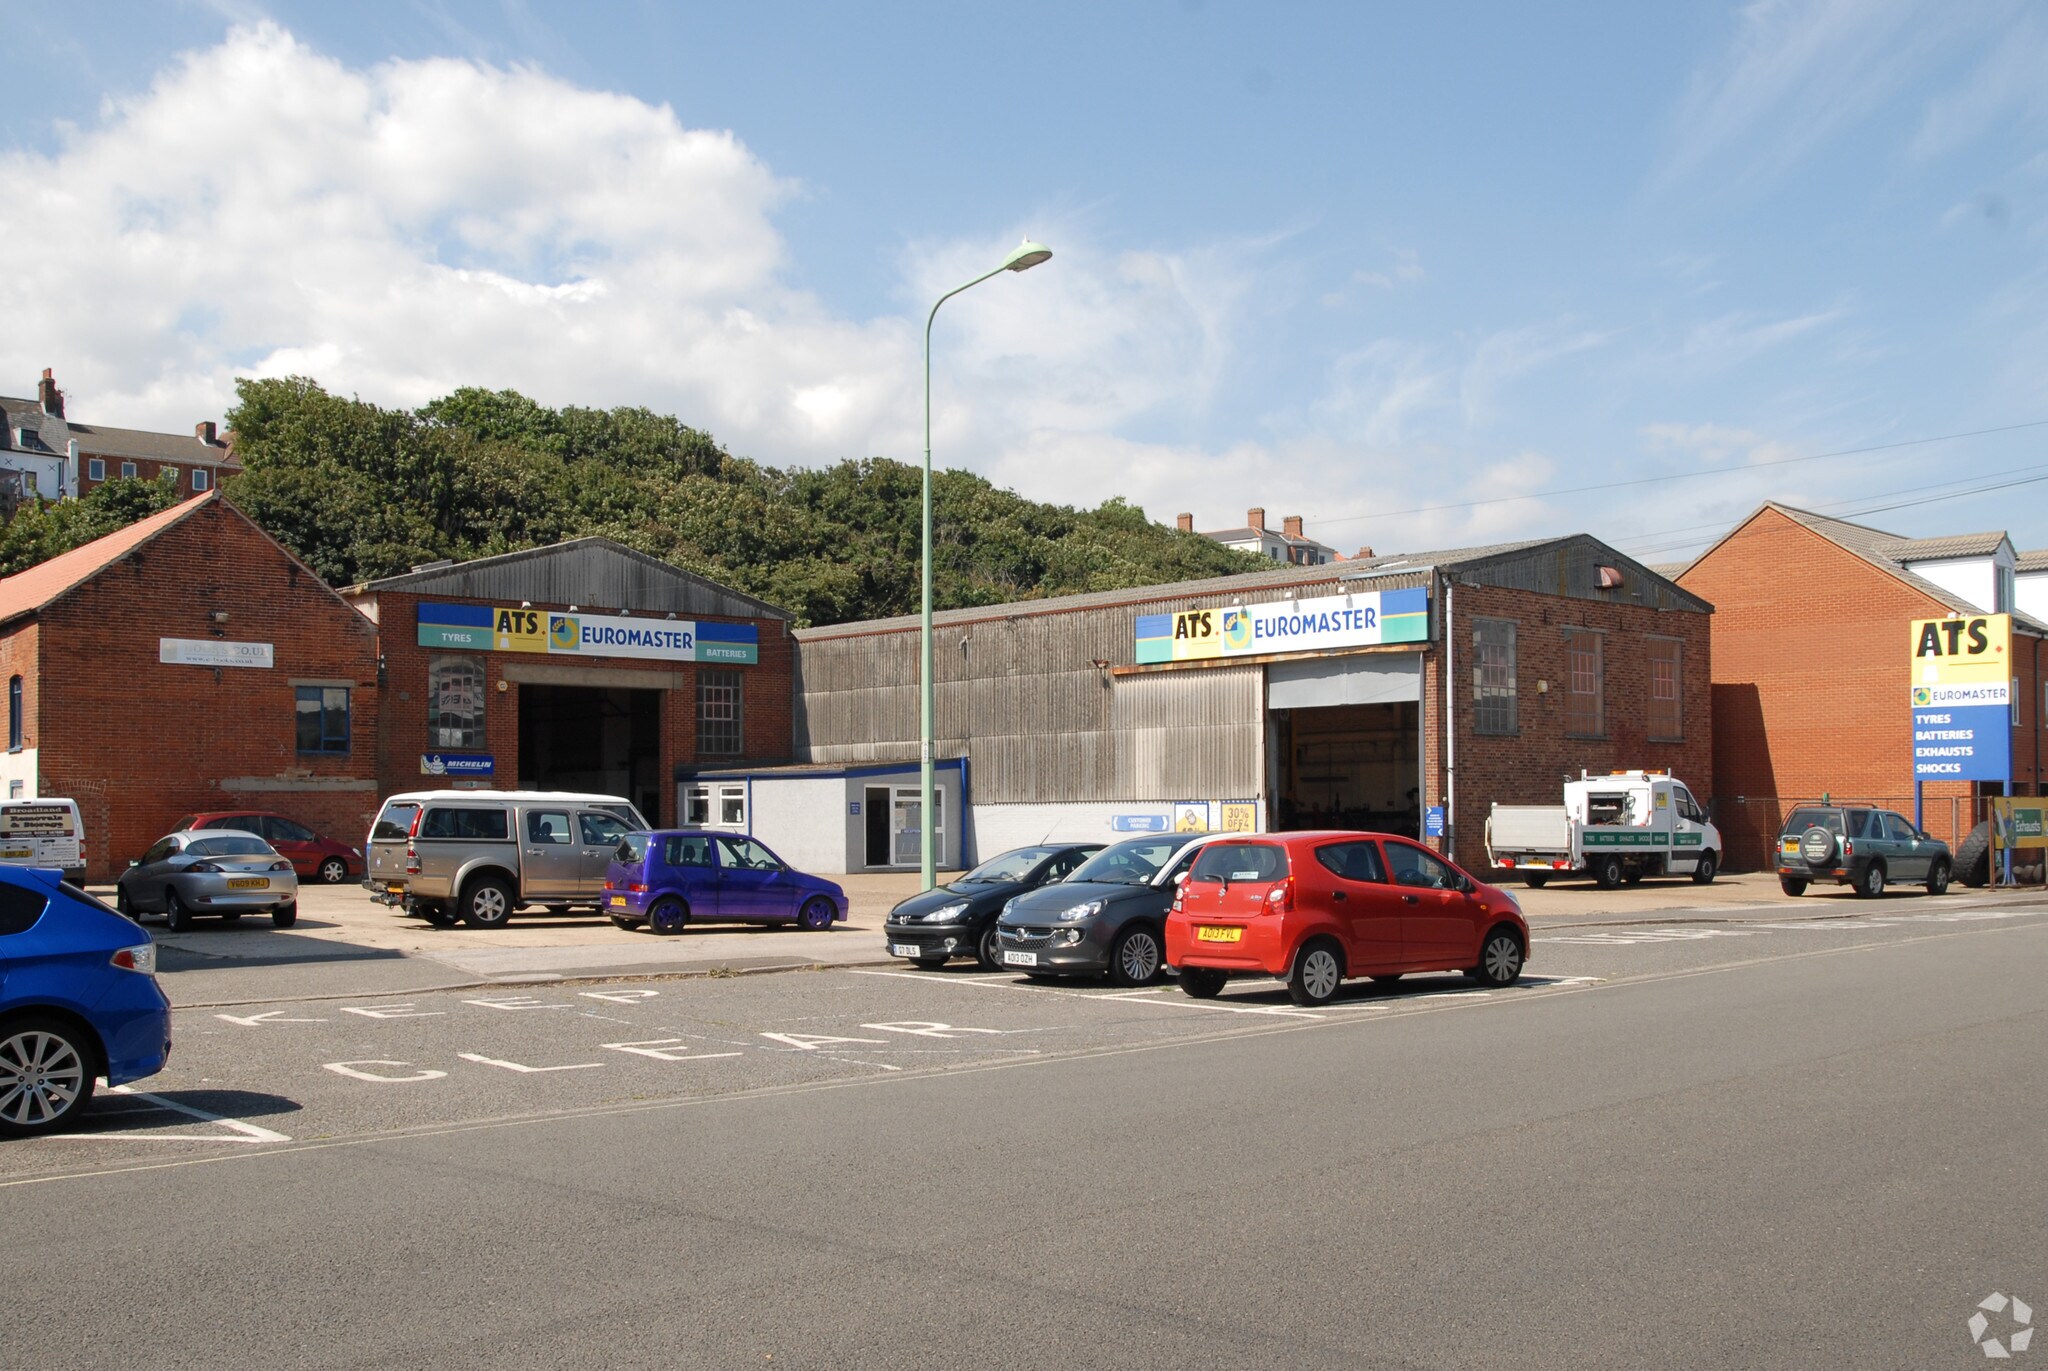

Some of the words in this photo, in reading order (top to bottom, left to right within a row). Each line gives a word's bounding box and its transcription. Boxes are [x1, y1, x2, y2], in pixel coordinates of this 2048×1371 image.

[1254, 607, 1377, 639] EUROMASTER
[441, 632, 472, 643] TYRES
[581, 626, 693, 650] EUROMASTER
[706, 648, 747, 659] BATTERIES
[1933, 687, 2007, 701] EUROMASTER
[1915, 713, 1951, 725] TYRES
[1915, 729, 1973, 741] BATTERIES
[1915, 746, 1973, 757] EXHAUSTS
[447, 760, 492, 768] MICHELIN
[1915, 763, 1961, 774] SHOCKS
[1228, 807, 1249, 819] 30%
[213, 989, 660, 1026] KEEP
[322, 1021, 1003, 1083] CLEAR
